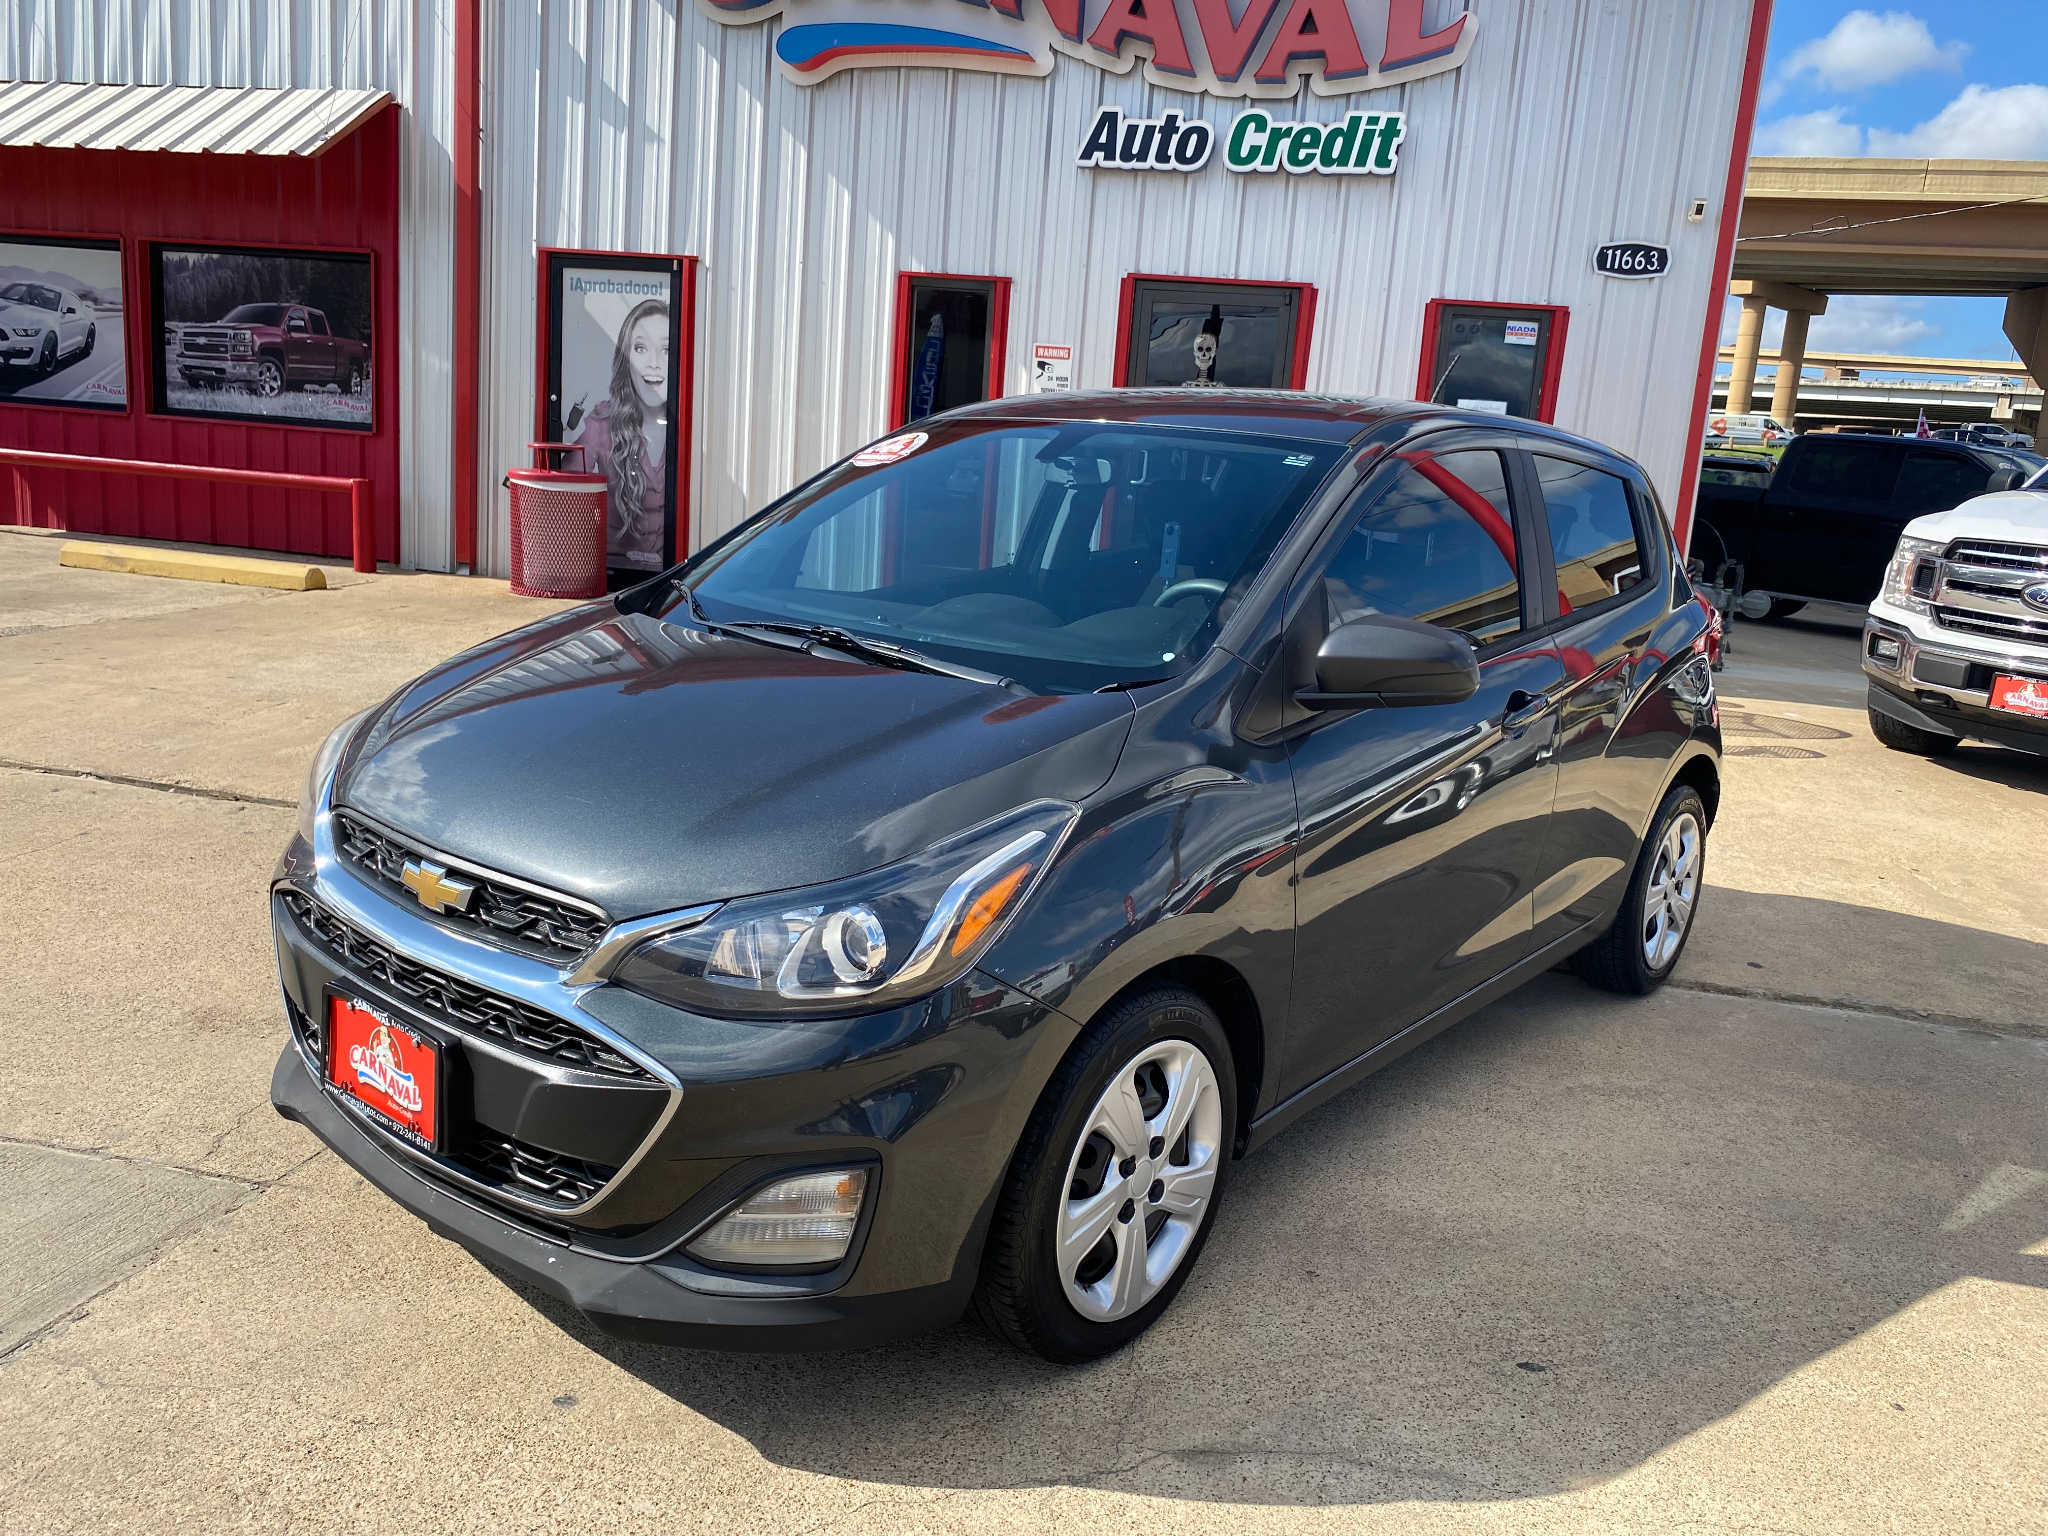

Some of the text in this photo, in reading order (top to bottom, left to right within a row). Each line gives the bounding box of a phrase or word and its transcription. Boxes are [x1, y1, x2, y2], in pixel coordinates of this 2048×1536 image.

[1078, 111, 1402, 168] Auto Credit
[1606, 249, 1660, 270] 11663
[569, 277, 663, 296] ¡Aprobadooo!
[1506, 325, 1536, 333] NIADA
[1037, 347, 1069, 358] WARNING
[86, 382, 126, 396] CARNAVAL
[326, 398, 369, 412] CARNAVAL
[353, 997, 390, 1027] CARNAVAL
[391, 1018, 405, 1034] Auto
[350, 1045, 421, 1106] CARNAVAL
[324, 1082, 432, 1152] www.CarnavalAutos.com 972-241-8141
[387, 1099, 413, 1119] Auto Credit
